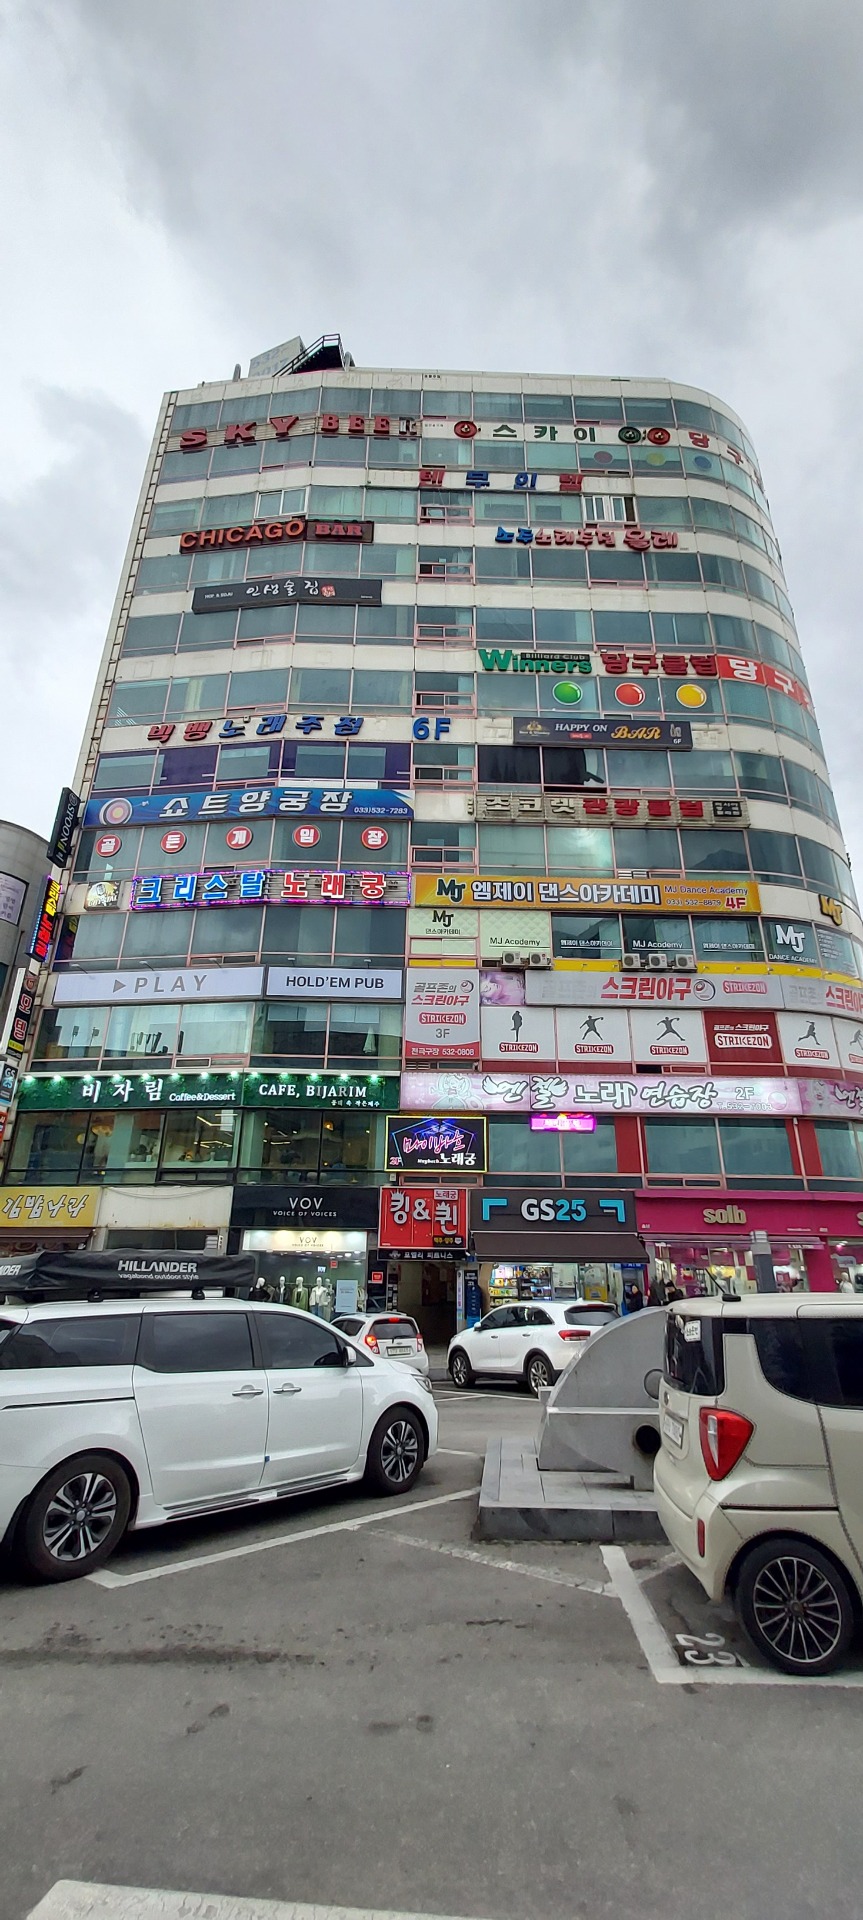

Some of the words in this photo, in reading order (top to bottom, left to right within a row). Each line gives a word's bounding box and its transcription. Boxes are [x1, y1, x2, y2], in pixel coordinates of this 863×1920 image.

[180, 416, 299, 449] SKY
[493, 425, 596, 442] 스카이
[180, 519, 305, 548] CHICAGO
[315, 524, 363, 537] BAR
[478, 649, 592, 674] Winners
[600, 653, 717, 676] 당구클럽
[219, 715, 365, 737] 노래주점
[413, 717, 451, 740] 6F
[555, 723, 589, 732] HAPPY
[592, 724, 607, 732] ON
[611, 725, 661, 740] BAR
[159, 790, 352, 818] 쇼트양궁장
[354, 806, 408, 815] 033)532-7283
[137, 872, 266, 904] 크리스탈
[281, 872, 385, 899] 노래궁
[437, 878, 465, 902] MJ
[471, 881, 533, 902] 엠제이
[538, 882, 662, 905] 댄스아카데미
[680, 886, 707, 894] Dance
[709, 886, 748, 895] Academy
[725, 896, 746, 909] 4F
[819, 894, 843, 926] MJ
[432, 910, 454, 927] MJ
[490, 937, 503, 945] MJ
[633, 940, 646, 948] MJ
[775, 925, 805, 953] MJ
[769, 953, 790, 961] DANCE
[791, 955, 817, 965] ACADEMY
[134, 975, 208, 993] PLAY
[286, 976, 351, 988] HOLD'EM
[355, 977, 384, 989] PUB
[414, 982, 457, 993] 골프존의
[601, 977, 691, 1000] 스크린야구
[724, 981, 766, 993] STRIKEZON
[412, 995, 470, 1006] 스크린야구
[421, 1013, 465, 1024] STRIKEZON
[435, 1028, 450, 1038] 3F
[718, 1034, 770, 1047] STRIKEZON
[442, 1048, 474, 1056] 532-0808
[500, 1043, 537, 1052] STRIKEZON
[576, 1045, 613, 1053] STRIKEZON
[651, 1046, 688, 1054] STRIKEZON
[4, 1068, 16, 1077] GS
[83, 1078, 163, 1102] 비자림
[259, 1084, 300, 1098] CAFE,
[306, 1085, 367, 1098] BIJARIM
[574, 1080, 637, 1109] 노래
[641, 1080, 719, 1109] 연습장
[735, 1087, 754, 1100] 2F
[169, 1092, 236, 1102] Coffee&Dessert
[440, 1152, 477, 1165] 노래궁
[435, 1191, 457, 1200] 노래궁
[2, 1195, 89, 1219] 김밥나라
[289, 1197, 323, 1209] VOV
[390, 1190, 458, 1235] 킹&퀸
[521, 1199, 587, 1222] GS25
[703, 1205, 747, 1224] solb
[118, 1260, 198, 1273] HILLANDER
